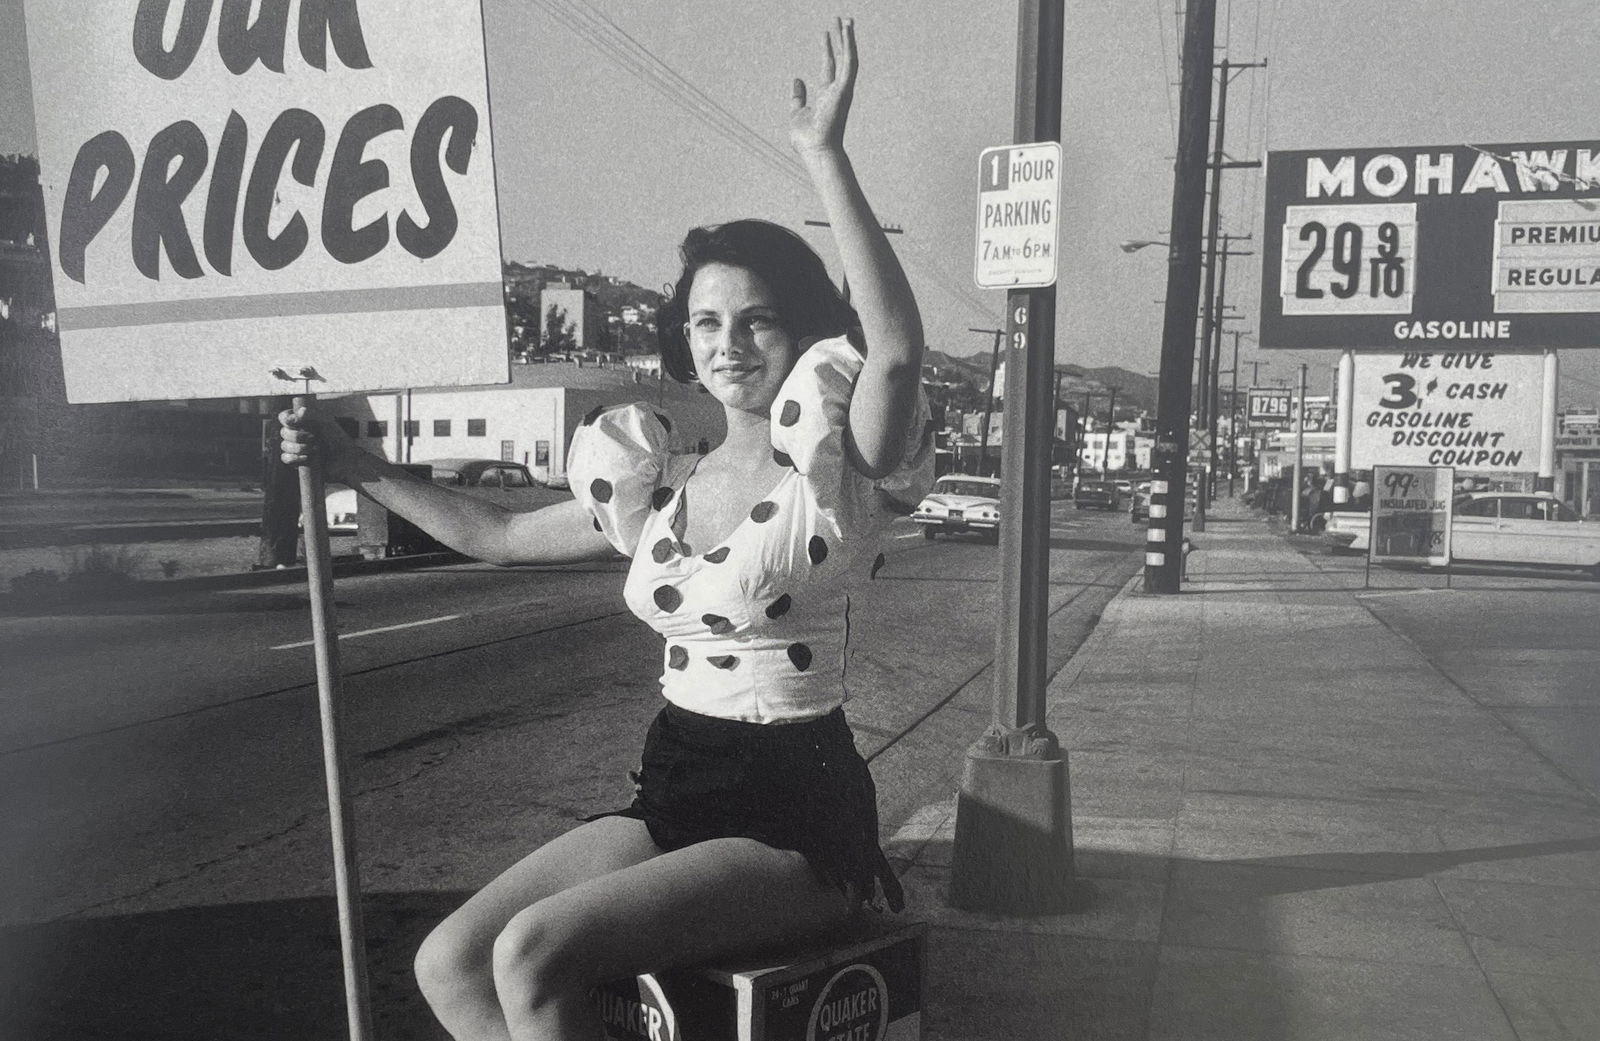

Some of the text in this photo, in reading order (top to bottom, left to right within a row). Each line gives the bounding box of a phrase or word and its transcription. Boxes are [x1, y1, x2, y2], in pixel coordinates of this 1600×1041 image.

[991, 155, 1054, 186] 1 HOUR
[1305, 149, 1600, 198] MOHAWK
[59, 95, 478, 285] PRICES
[984, 200, 1051, 229] PARKING
[1394, 321, 1511, 339] GASOLINE
[1400, 352, 1495, 369] WE GIVE
[1445, 383, 1508, 400] CASH
[1366, 411, 1474, 428] GASOLINE
[1391, 431, 1505, 448] DISCOUNT
[1428, 450, 1523, 467] COUPON
[820, 987, 877, 1032] QUAKER
